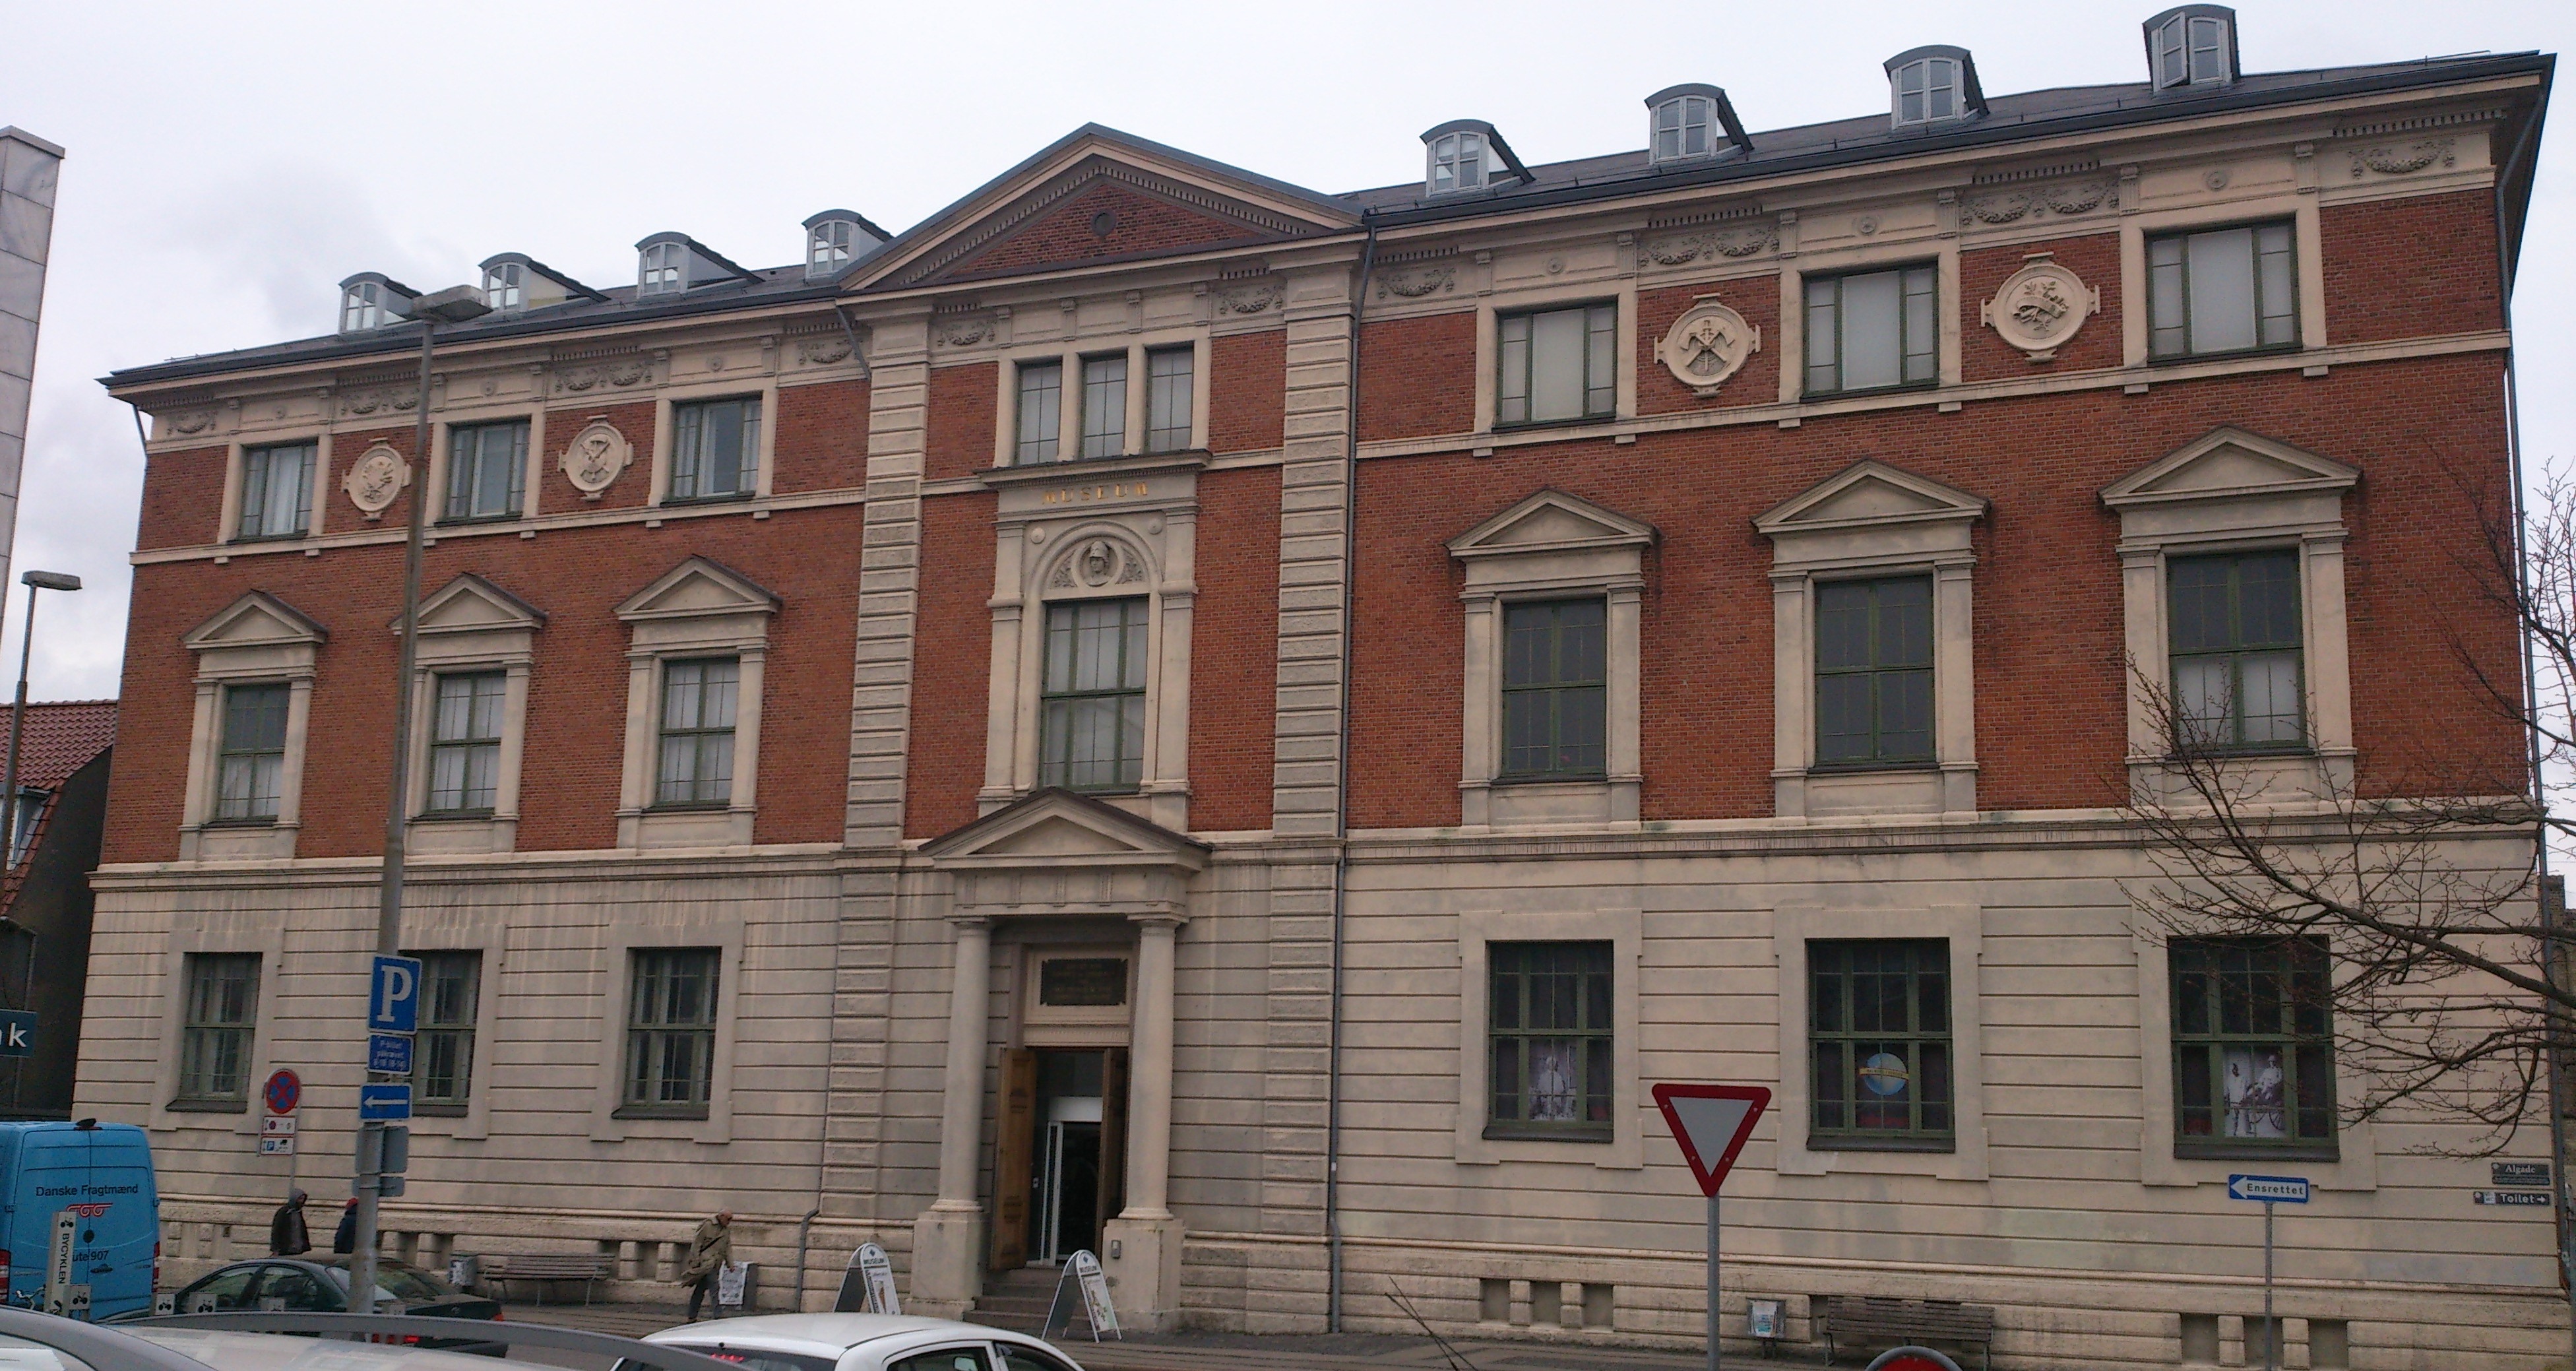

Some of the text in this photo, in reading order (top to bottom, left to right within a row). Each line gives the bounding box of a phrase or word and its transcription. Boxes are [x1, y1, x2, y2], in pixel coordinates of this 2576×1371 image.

[1042, 482, 1148, 505] MUSEUM
[377, 965, 412, 1022] P
[0, 1022, 26, 1047] k
[2505, 1164, 2536, 1174] Algade
[36, 1184, 139, 1197] Danske Fragtmænd
[2247, 1183, 2304, 1195] Ensrettet
[2500, 1194, 2535, 1203] Toilet
[58, 1233, 71, 1284] BYCYKLEN
[72, 1251, 109, 1262] ute 907
